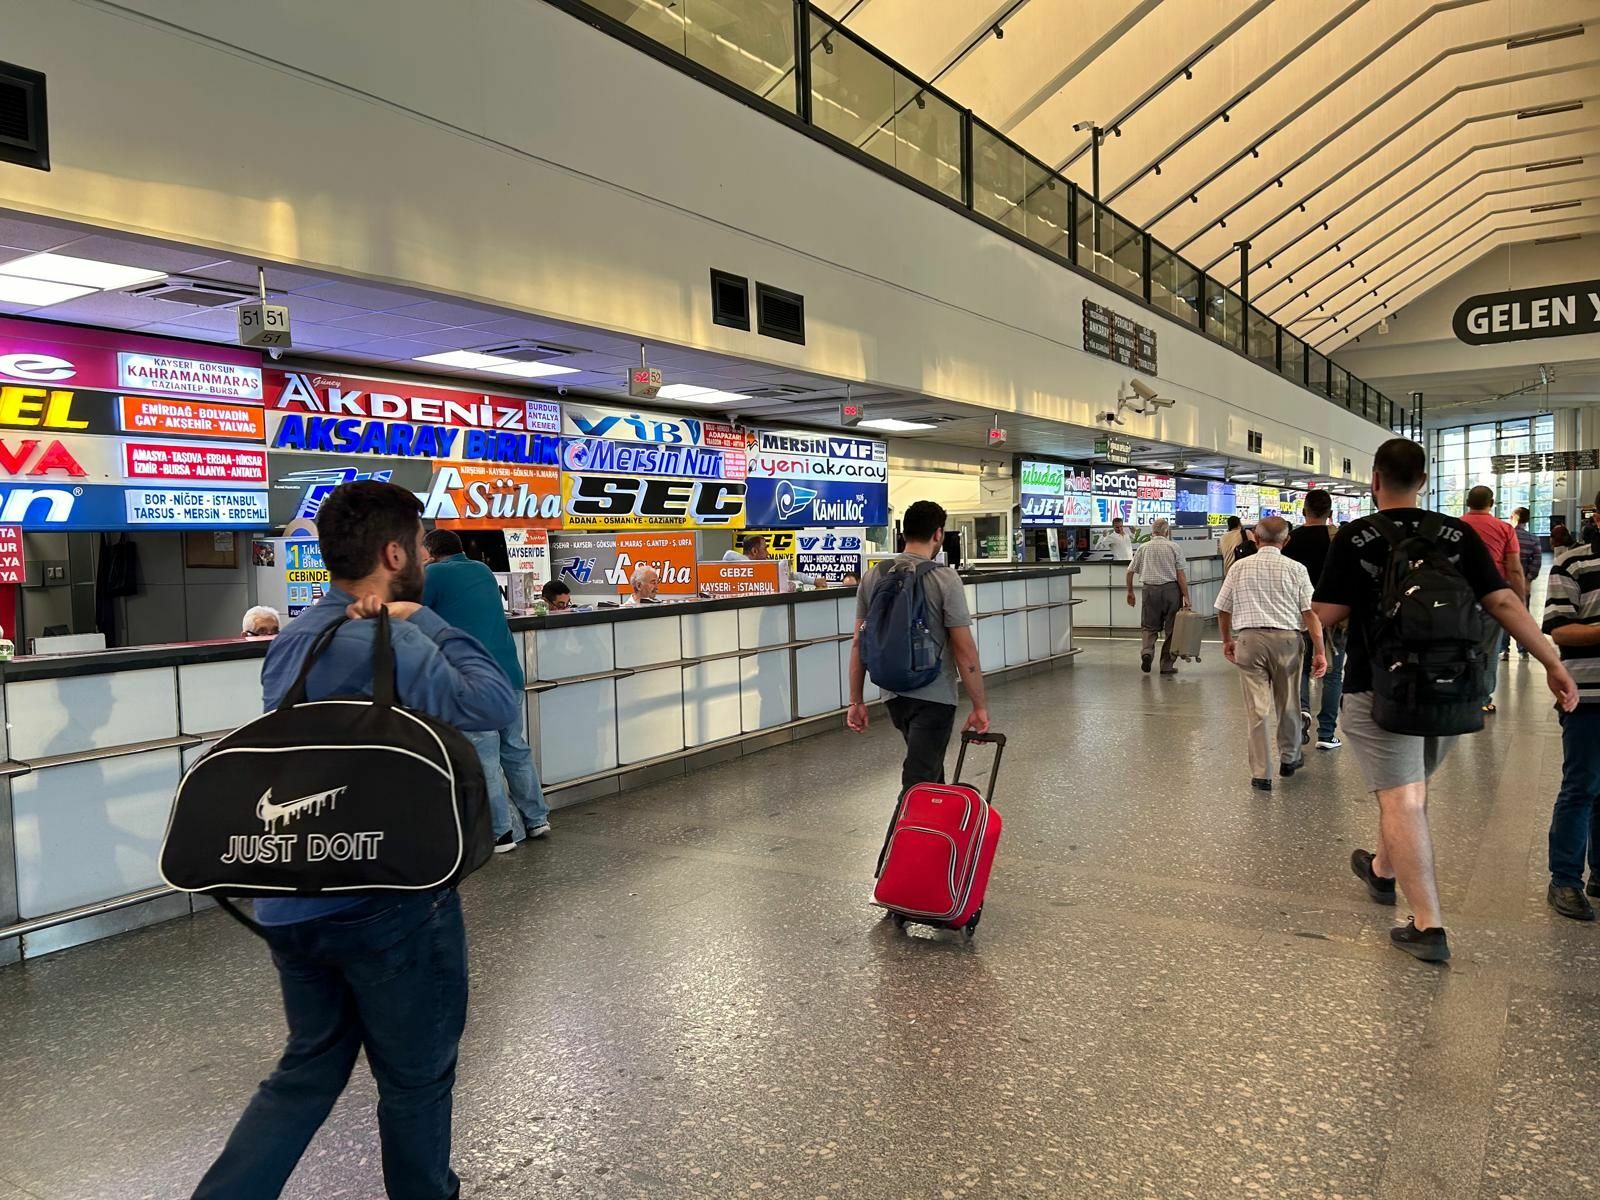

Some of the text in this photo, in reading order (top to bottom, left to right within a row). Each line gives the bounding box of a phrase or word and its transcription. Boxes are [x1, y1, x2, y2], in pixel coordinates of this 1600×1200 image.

[243, 310, 259, 326] 51
[266, 310, 284, 326] 51
[1466, 295, 1576, 335] GELEN
[127, 364, 259, 390] KAHRAMANMARAŞ
[528, 402, 558, 413] BURDUR
[528, 411, 559, 421] ANTALYA
[134, 415, 158, 427] ÇAY
[218, 421, 257, 434] YALVAÇ
[531, 421, 556, 430] KEMER
[272, 413, 459, 457] AKSARAY
[590, 441, 679, 475] Mersin
[682, 448, 723, 478] Nur
[760, 458, 809, 477] yeni
[812, 459, 887, 483] aksaray
[144, 493, 166, 505] BOR
[465, 478, 562, 519] Süha
[133, 507, 175, 519] TARSUS
[569, 516, 597, 524] ADANA
[290, 545, 299, 569] 1
[302, 558, 323, 568] Bilet
[815, 555, 836, 563] HENDEK
[719, 567, 754, 577] GEBZE
[803, 564, 855, 573] ADAPAZARI
[220, 834, 298, 864] JUST
